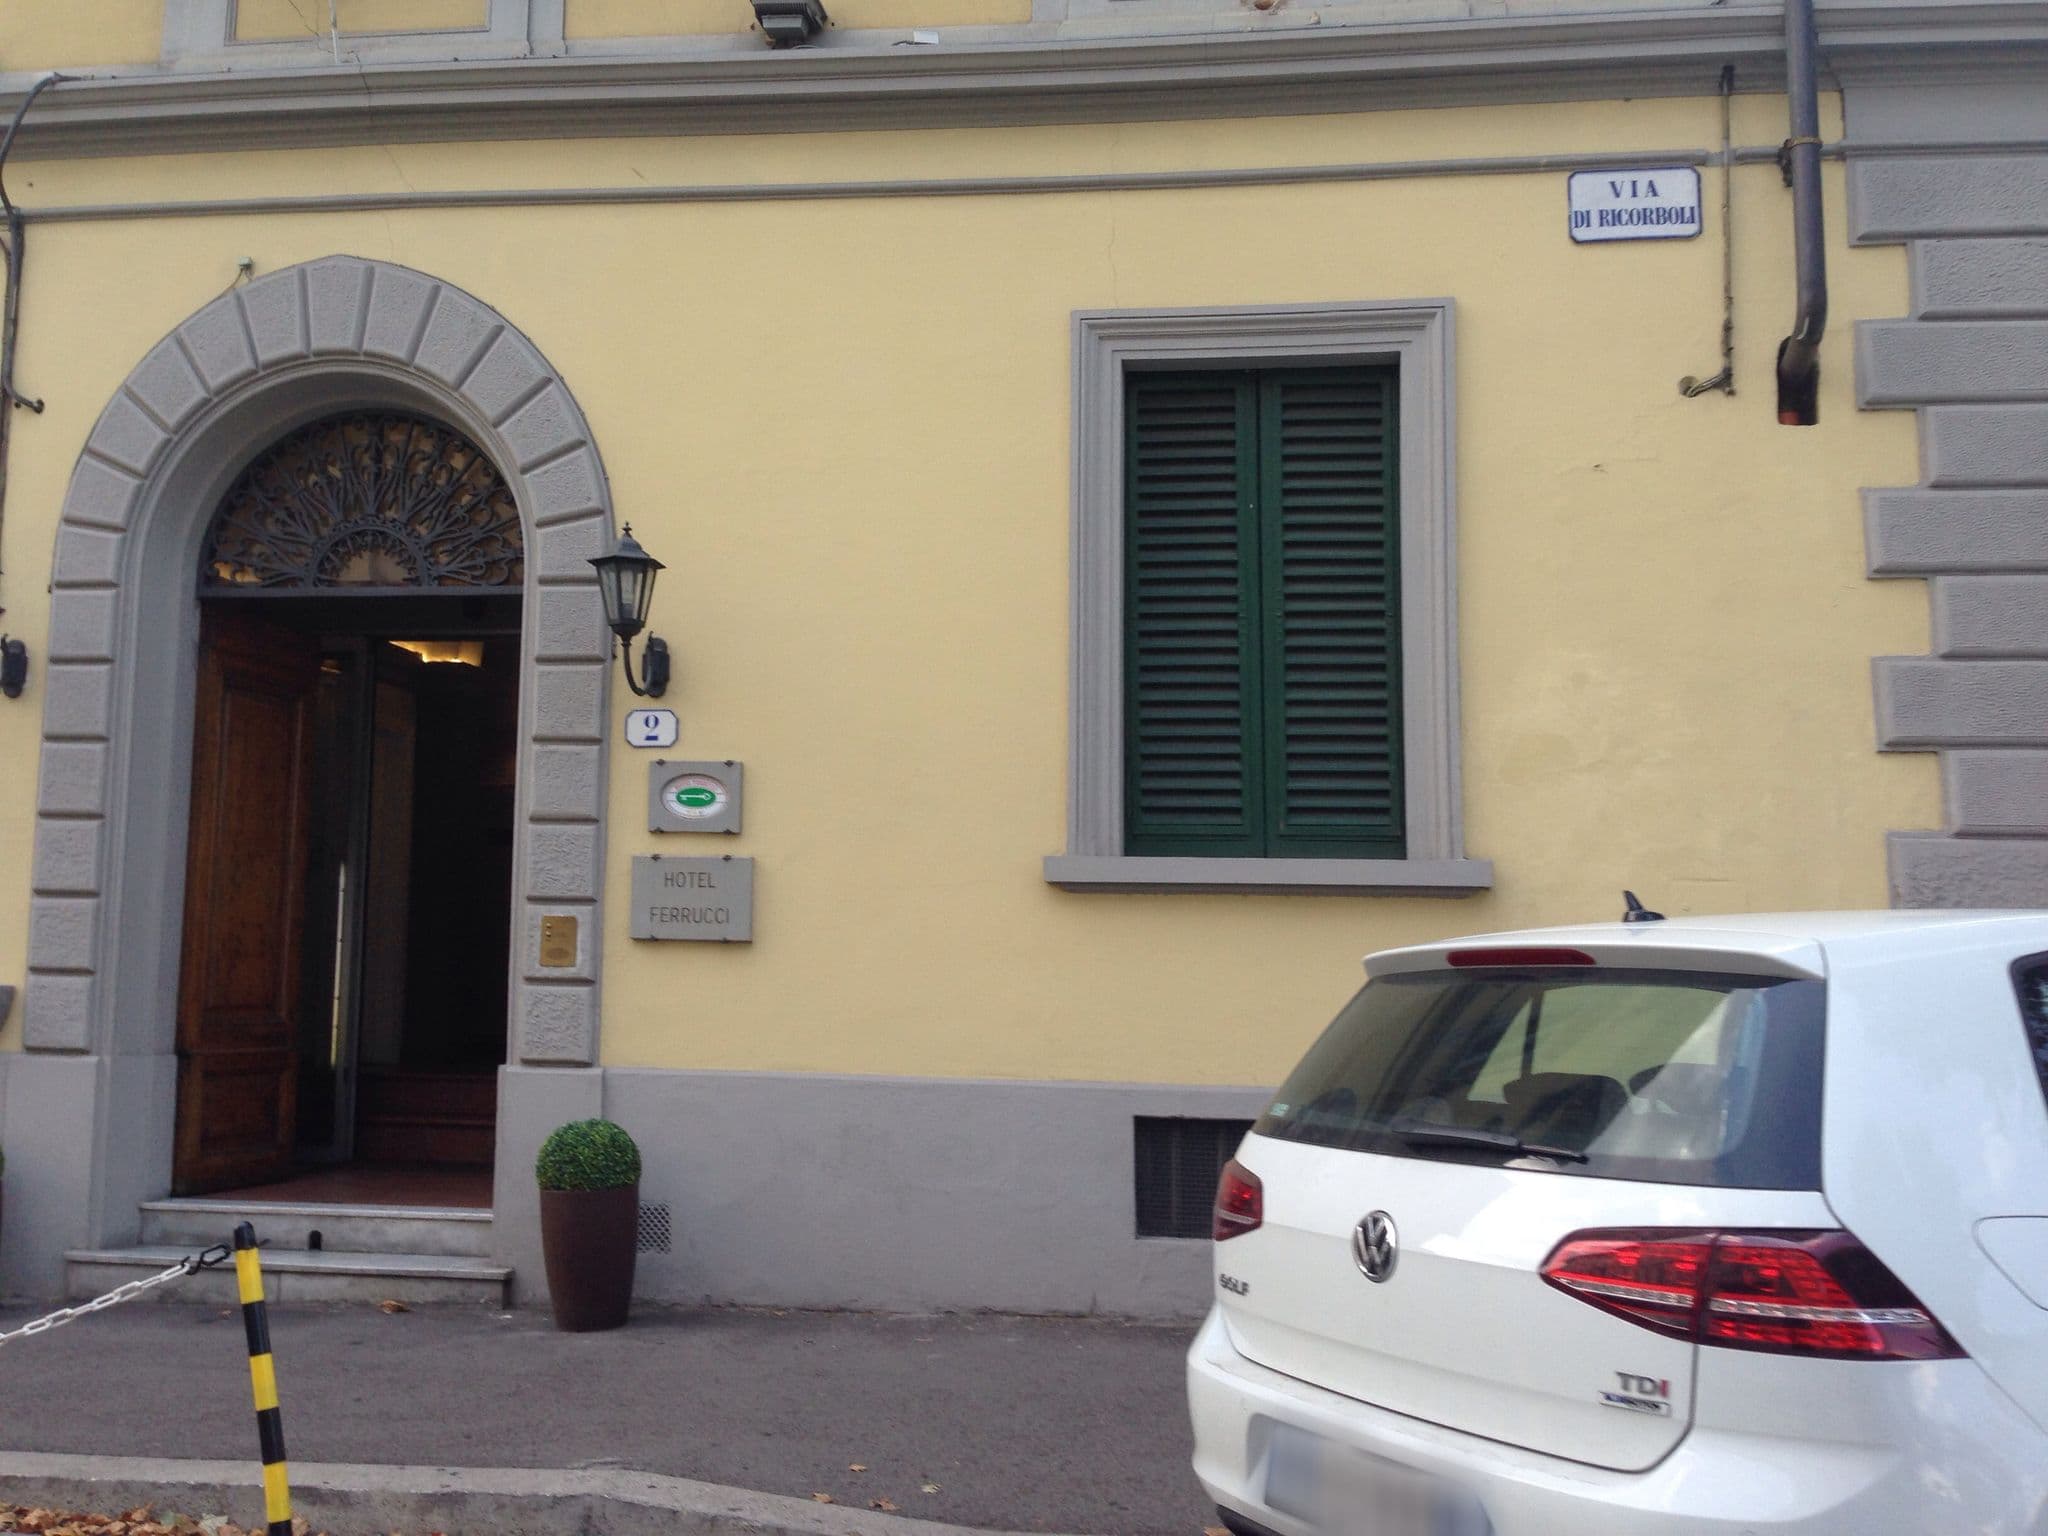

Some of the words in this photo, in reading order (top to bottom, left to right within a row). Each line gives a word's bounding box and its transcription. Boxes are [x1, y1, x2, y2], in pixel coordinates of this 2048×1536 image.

[1609, 179, 1660, 199] VIA
[1573, 209, 1591, 228] DI
[1598, 206, 1696, 228] RICORBOLI
[644, 714, 659, 741] 2
[663, 871, 717, 889] HOTEL
[649, 906, 730, 925] FERRUCCI
[1614, 1370, 1670, 1399] TDI
